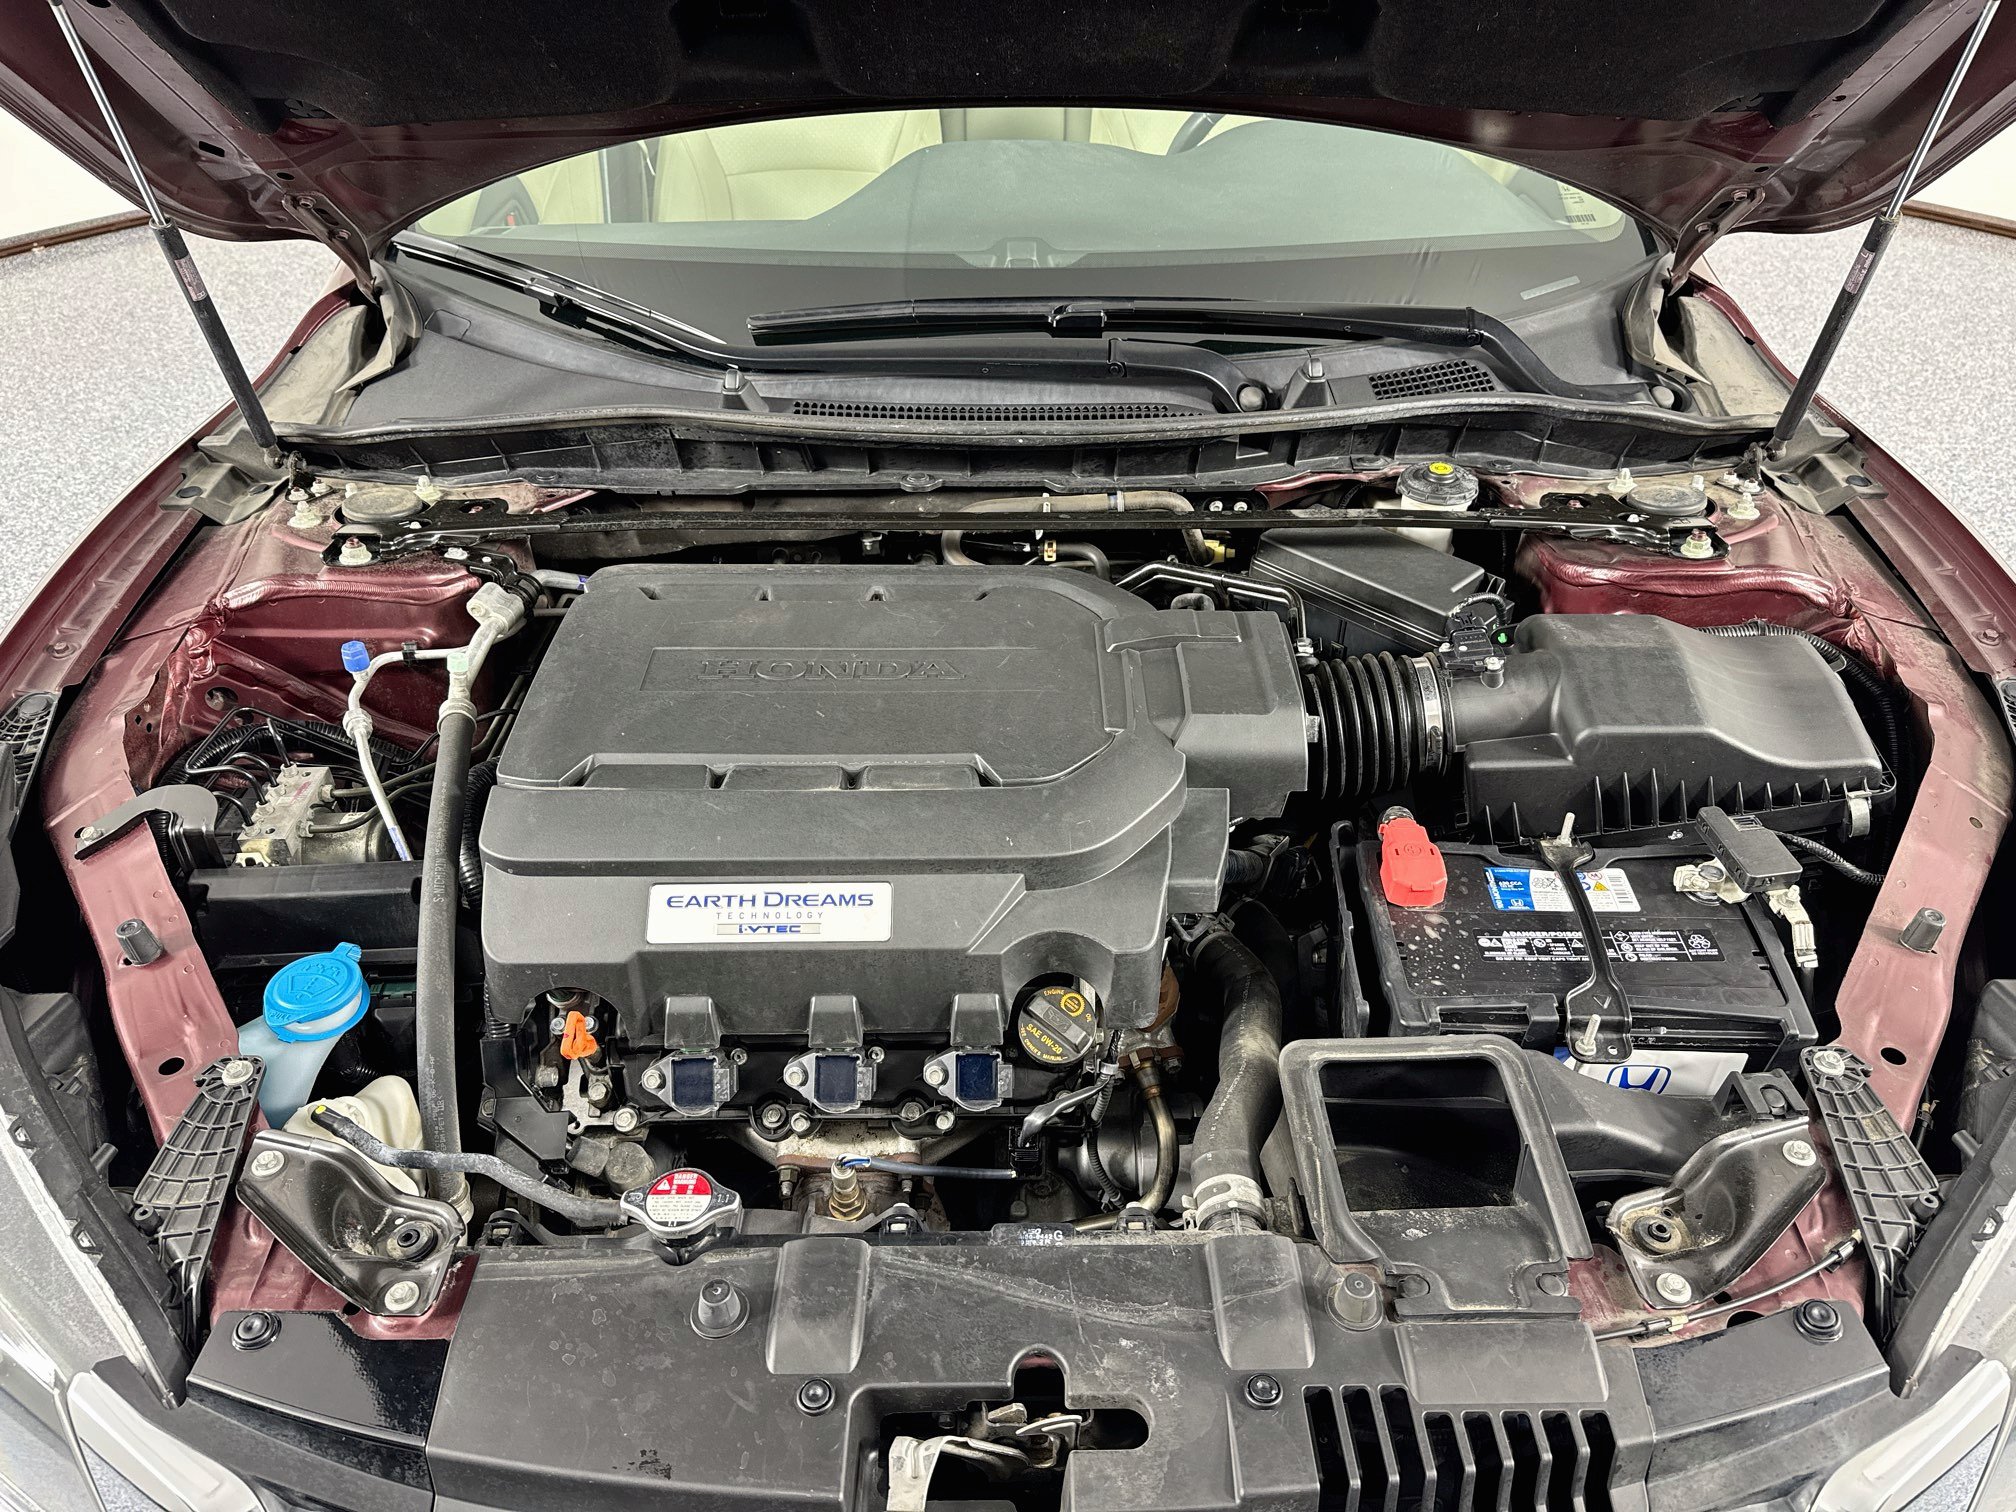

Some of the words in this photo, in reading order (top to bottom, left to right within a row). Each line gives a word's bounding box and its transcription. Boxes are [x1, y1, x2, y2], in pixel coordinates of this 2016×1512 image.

[698, 659, 967, 680] HONDA
[666, 894, 756, 908] EARTH
[764, 892, 874, 907] DREAMS
[1026, 1023, 1042, 1038] SAE
[1041, 1035, 1063, 1054] 0W-20
